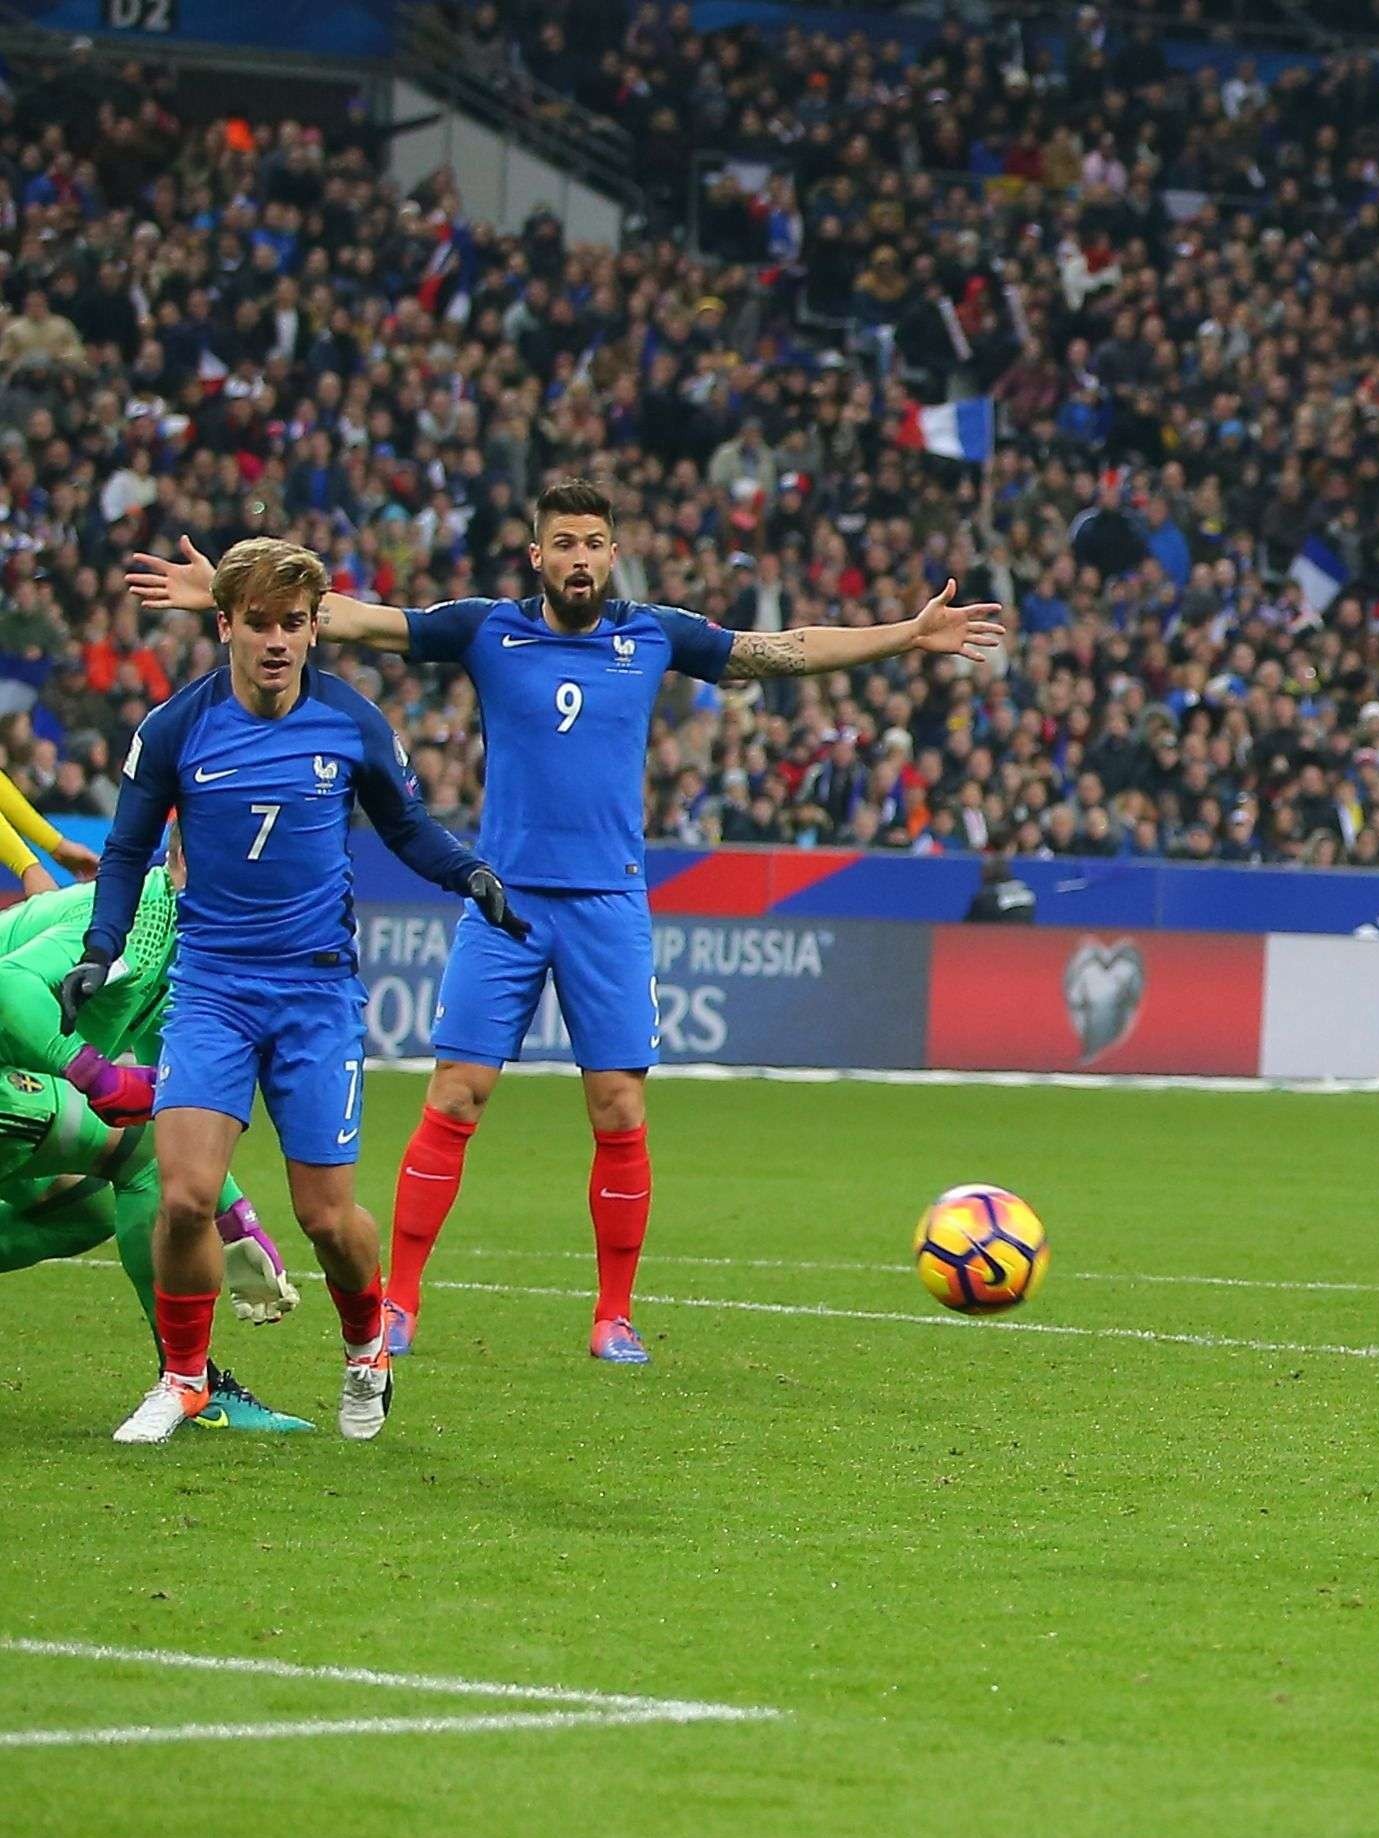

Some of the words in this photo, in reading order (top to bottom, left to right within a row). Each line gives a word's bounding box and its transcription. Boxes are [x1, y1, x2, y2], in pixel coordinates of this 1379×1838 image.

[556, 682, 583, 732] 9
[247, 804, 281, 861] 7
[369, 917, 449, 966] FIFA
[345, 1060, 358, 1120] 7
